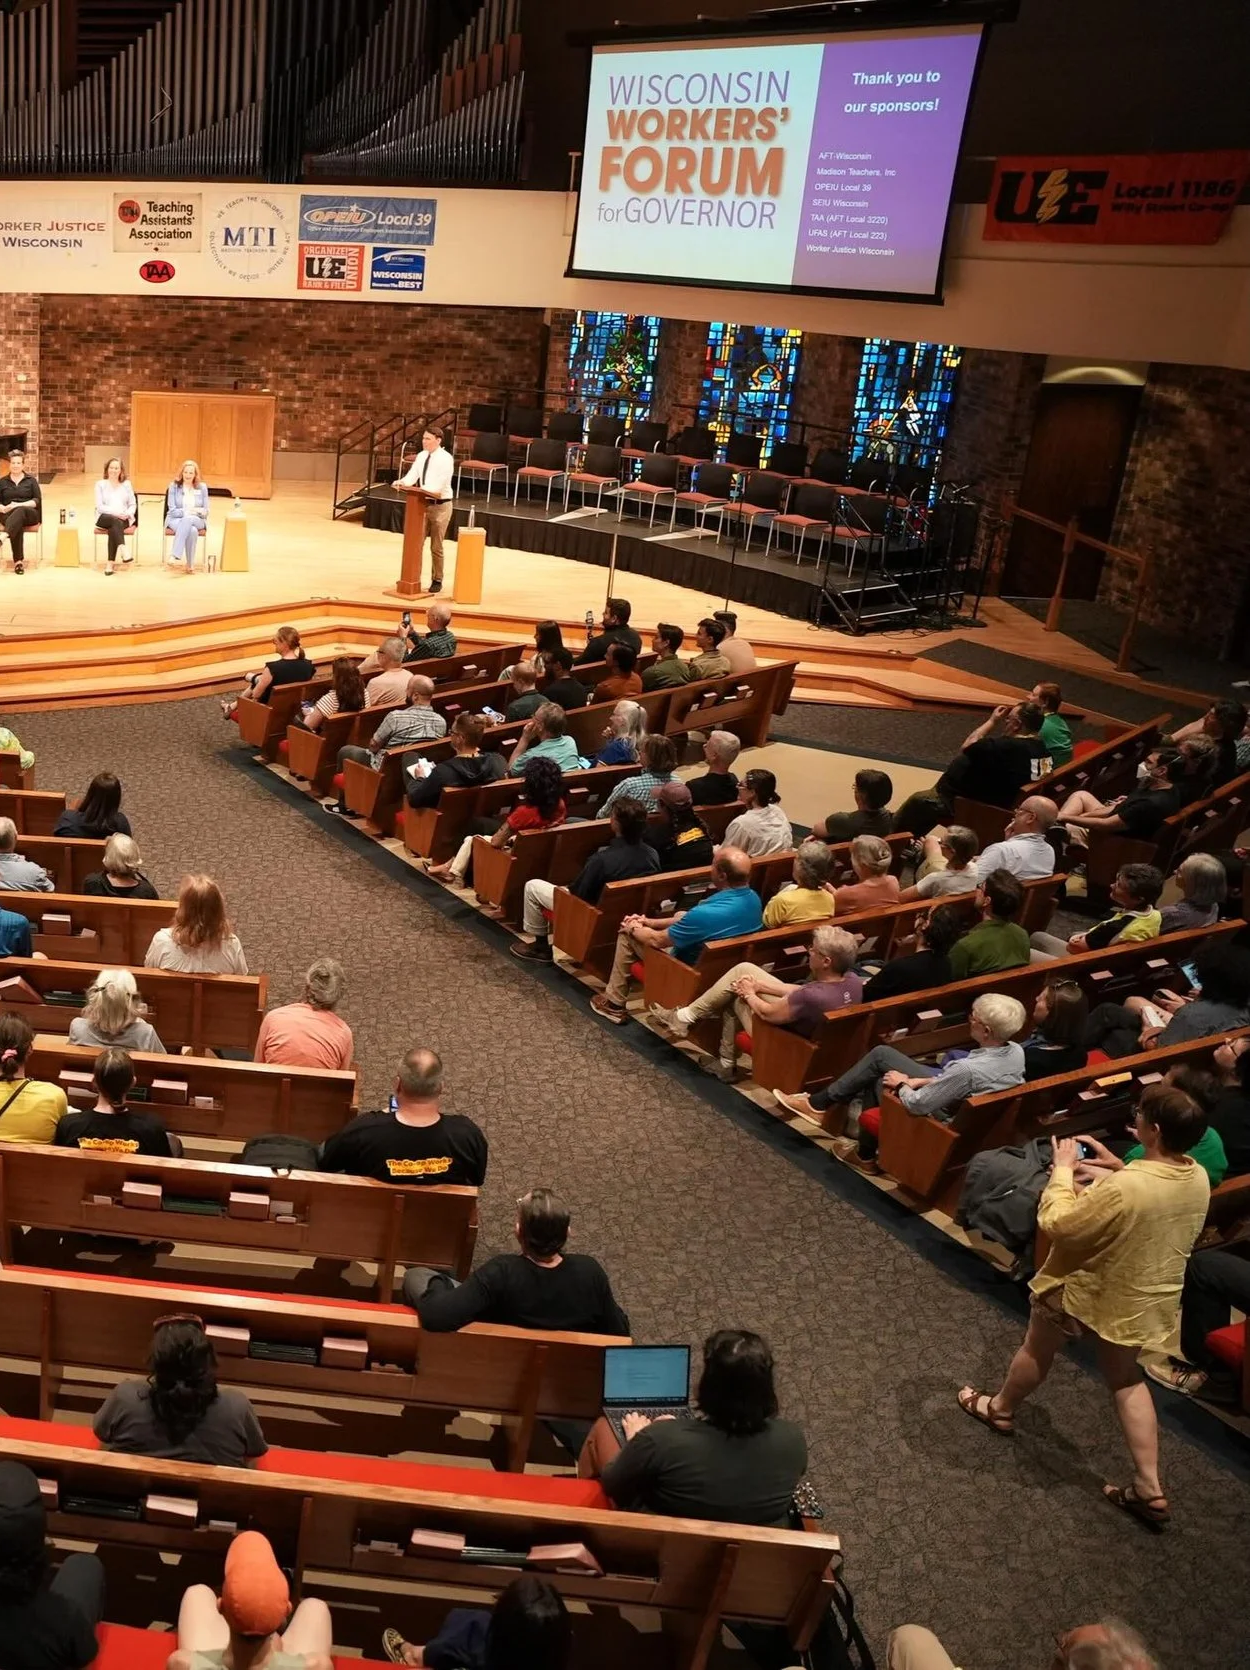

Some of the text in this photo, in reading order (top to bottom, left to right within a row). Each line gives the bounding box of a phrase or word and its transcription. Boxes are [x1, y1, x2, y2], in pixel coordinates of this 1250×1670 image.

[853, 71, 940, 86] Thank you to
[610, 71, 790, 105] WISCONSIN
[844, 99, 939, 114] our sponsors!
[607, 107, 790, 141] WORKERS'
[818, 152, 871, 160] AFT-Wisconsin
[599, 146, 784, 196] FORUM
[849, 168, 882, 177] Teachers,
[862, 184, 871, 192] 39
[1114, 179, 1236, 199] Local 1186
[147, 201, 193, 216] Teaching
[226, 198, 244, 209] TEACH
[261, 199, 284, 220] CHILDREN
[833, 200, 868, 208] Wisconsin
[1111, 203, 1142, 215] Willy
[1146, 203, 1184, 213] Street
[140, 214, 195, 225] Assistants'
[311, 211, 366, 224] OPEIU
[378, 212, 432, 226] Local 39
[811, 214, 888, 225] TAA (AFT Local 3220)
[47, 221, 106, 231] JUSTICE
[129, 228, 192, 239] Association
[223, 227, 276, 246] MTI
[808, 229, 887, 240] UFAS (AFT Local 223)
[2, 237, 83, 247] WISCONSIN
[304, 246, 346, 255] ORGANIZE
[806, 244, 895, 256] Worker Justice Wisconsin
[144, 264, 171, 279] TAA
[306, 257, 346, 279] UE
[346, 248, 359, 289] UNION
[373, 271, 422, 280] WISCONSIN
[303, 280, 323, 289] RANK
[331, 281, 346, 289] FILE
